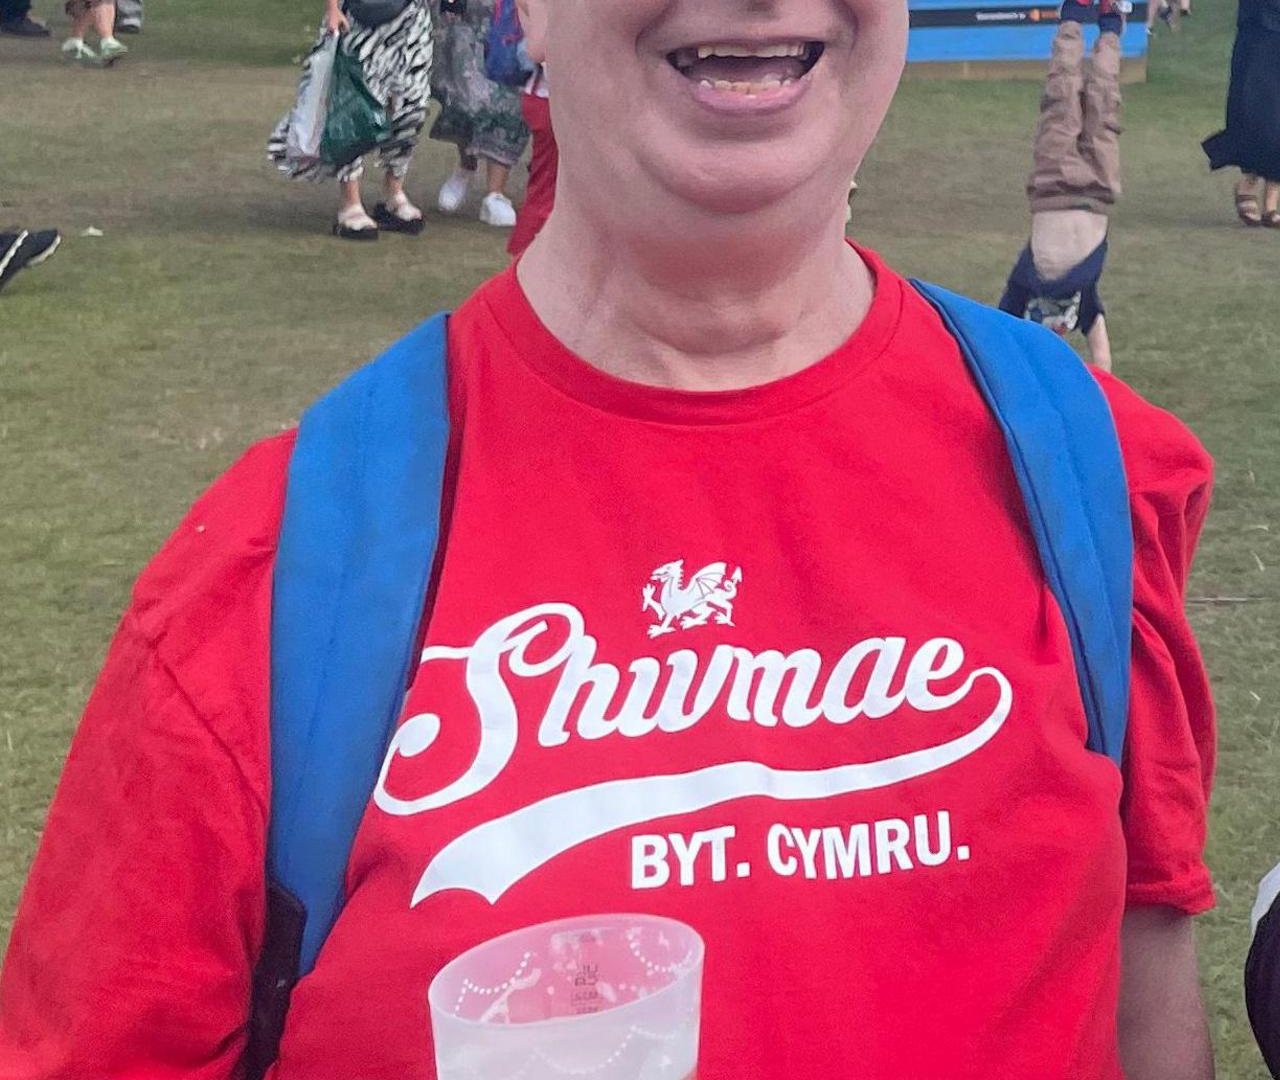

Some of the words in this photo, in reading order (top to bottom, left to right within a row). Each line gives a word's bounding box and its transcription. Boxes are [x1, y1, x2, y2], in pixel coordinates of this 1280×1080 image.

[373, 603, 1008, 815] Shumae
[631, 824, 749, 889] BYT.
[767, 810, 970, 881] CYMRU.
